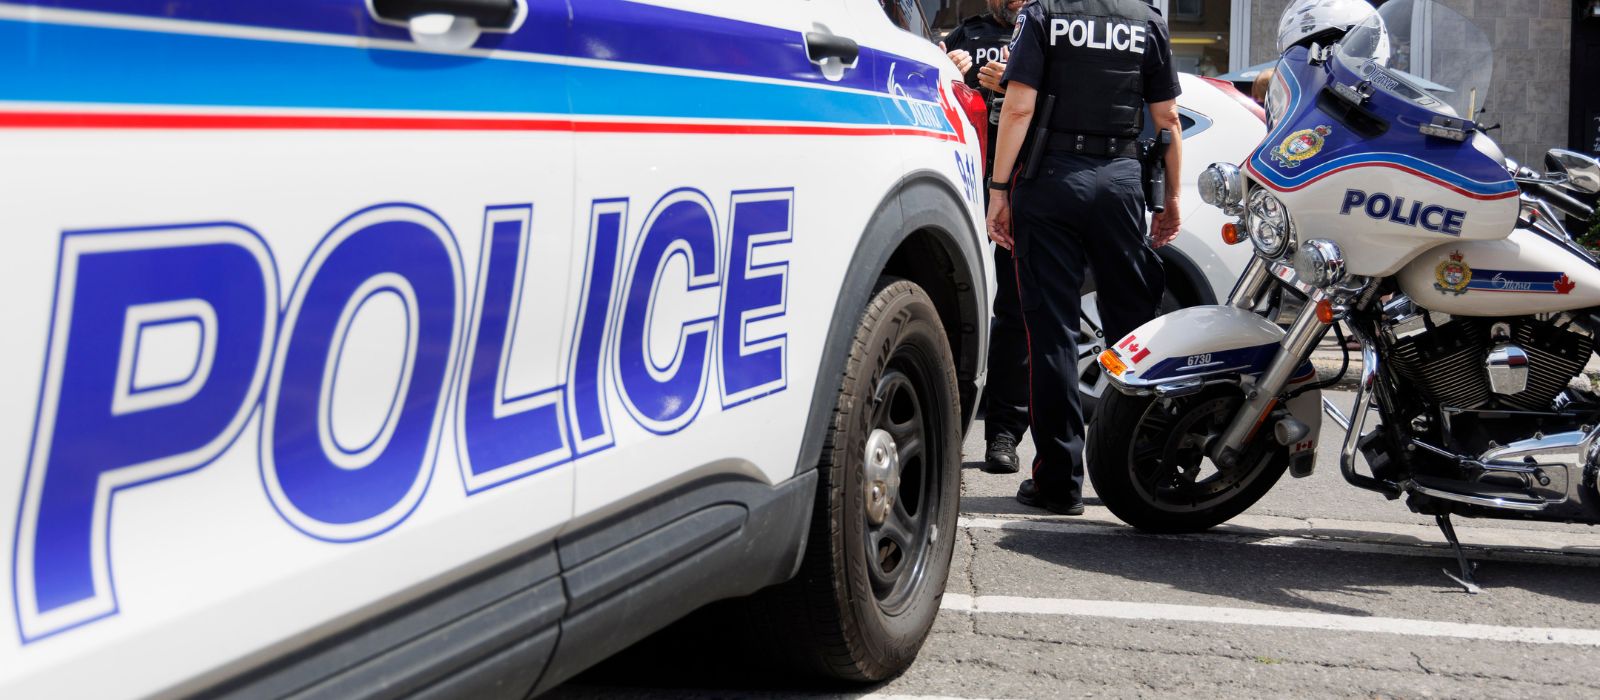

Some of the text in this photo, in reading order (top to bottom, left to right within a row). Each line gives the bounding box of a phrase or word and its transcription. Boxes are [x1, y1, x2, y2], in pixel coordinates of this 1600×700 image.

[1050, 18, 1145, 54] POLICE
[1360, 57, 1399, 91] Ottawa
[1339, 188, 1467, 237] POLICE
[1491, 272, 1532, 290] Ottawa
[1187, 353, 1212, 366] 6730
[13, 187, 795, 643] POLICE
